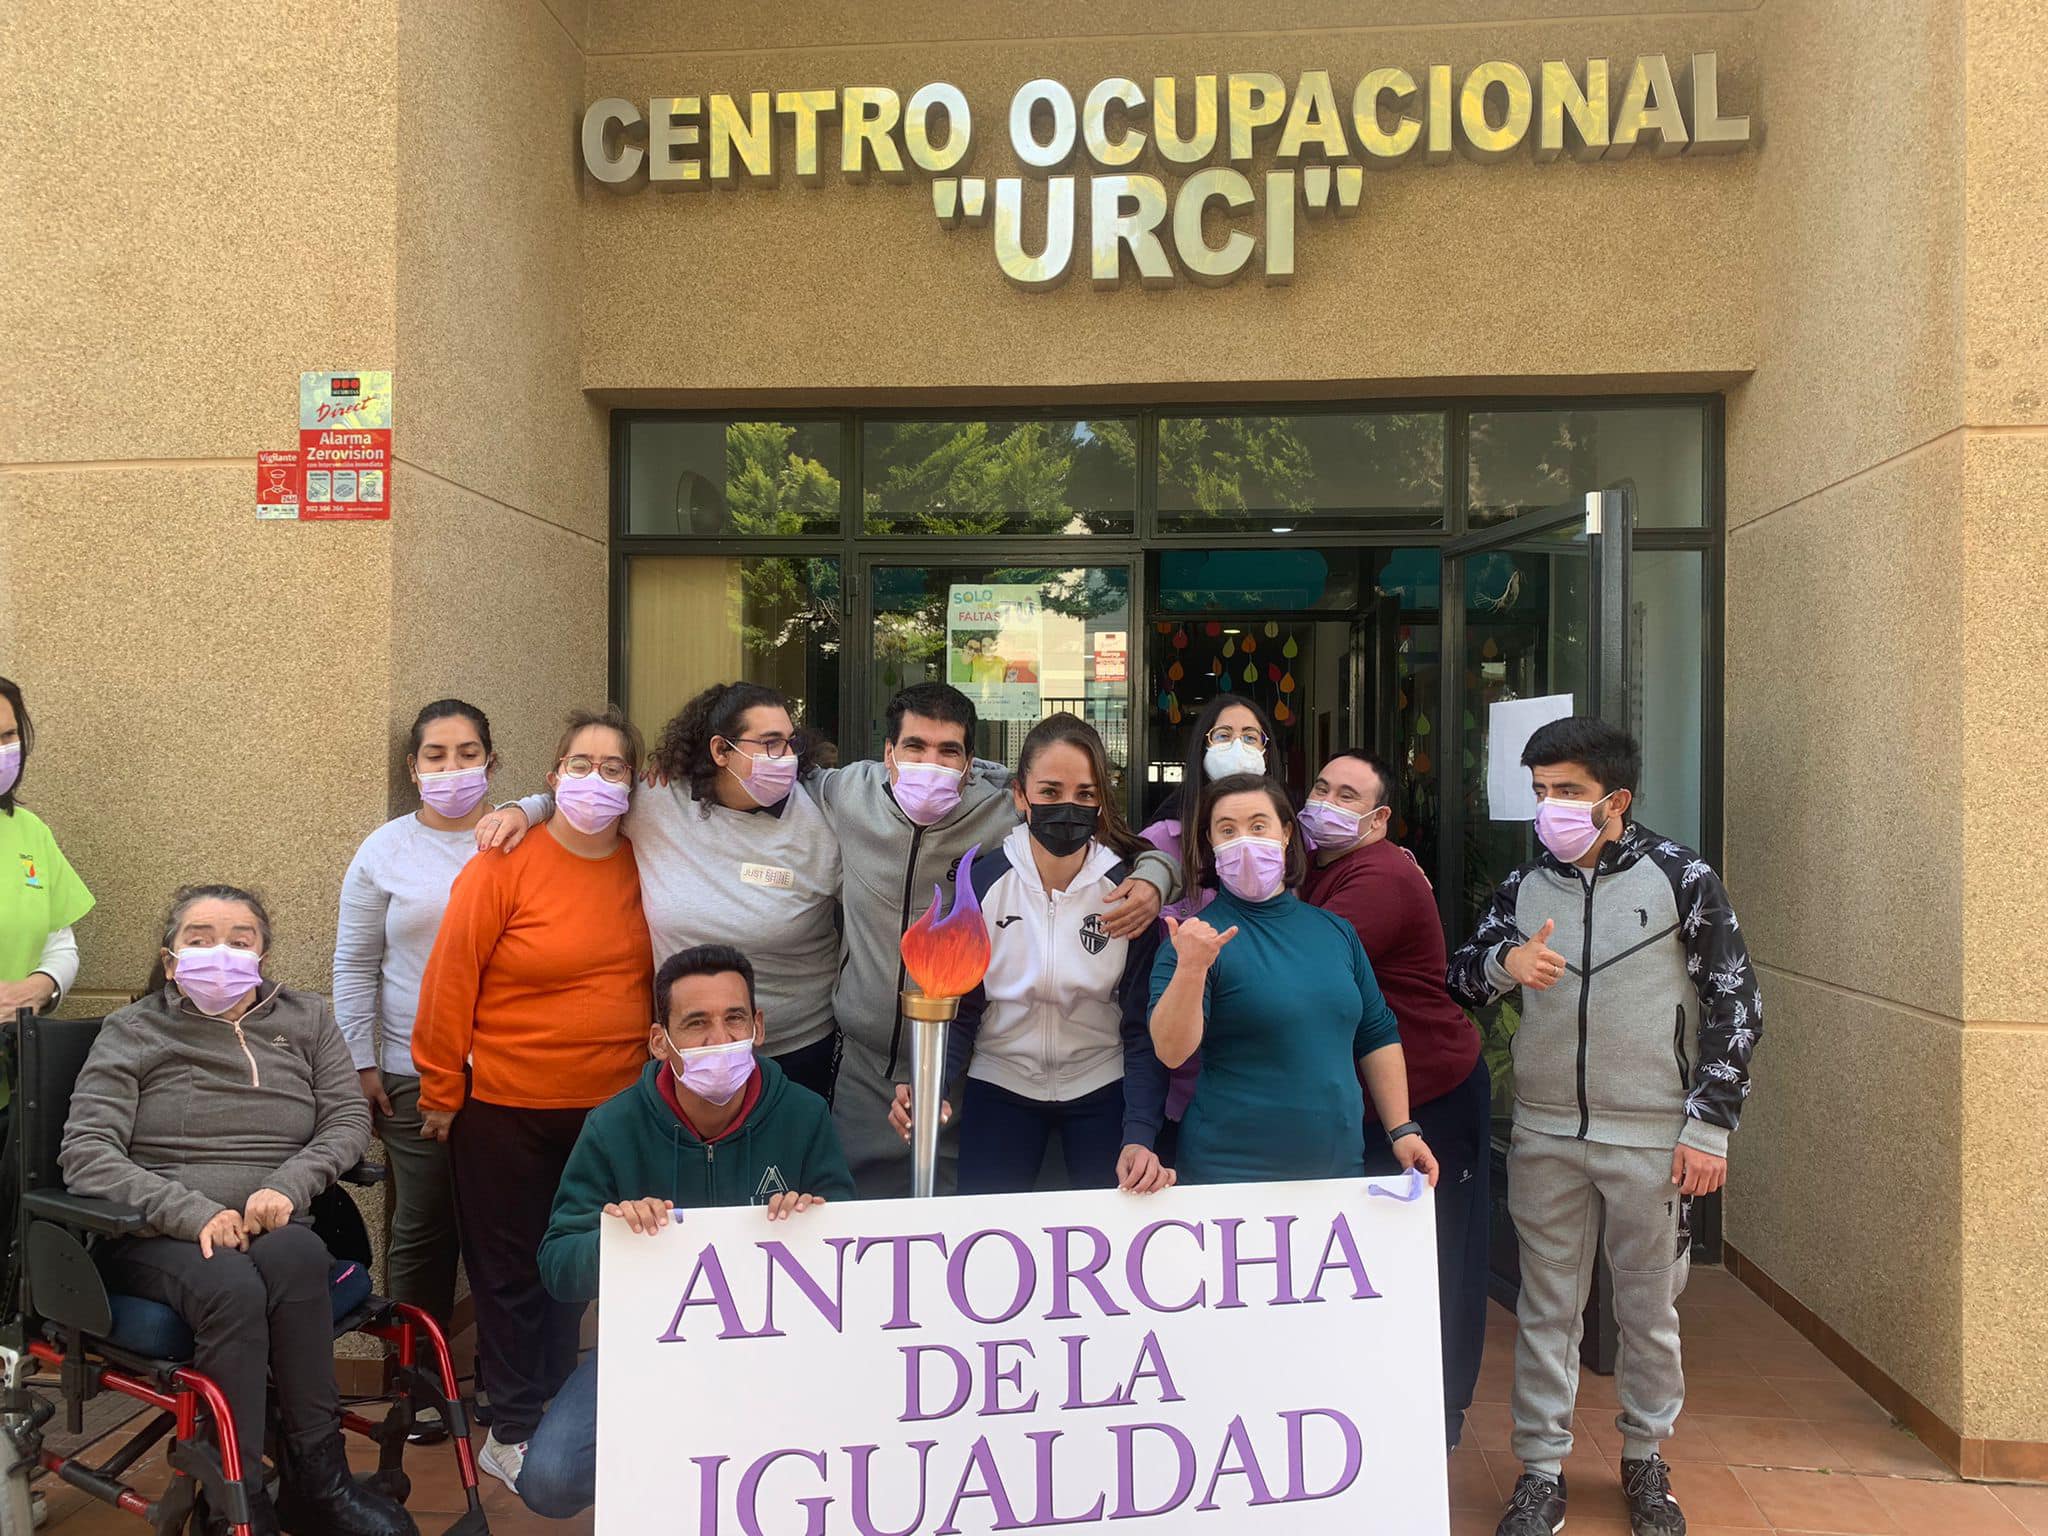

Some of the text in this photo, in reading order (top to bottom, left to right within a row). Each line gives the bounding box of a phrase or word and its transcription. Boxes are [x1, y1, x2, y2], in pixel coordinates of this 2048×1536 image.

[581, 50, 1752, 185] CENTRO OCUPACIONAL
[932, 165, 1365, 285] "URCI"
[316, 396, 375, 423] Direct
[319, 431, 373, 446] Alarma
[259, 453, 298, 464] Vigilante
[306, 446, 385, 461] Zerovision
[953, 589, 993, 605] SOLO
[958, 611, 1001, 623] FALTAS
[656, 1209, 1383, 1343] ANTORCHA
[897, 1329, 1186, 1422] DE LA
[689, 1407, 1363, 1536] IGUALDAD
